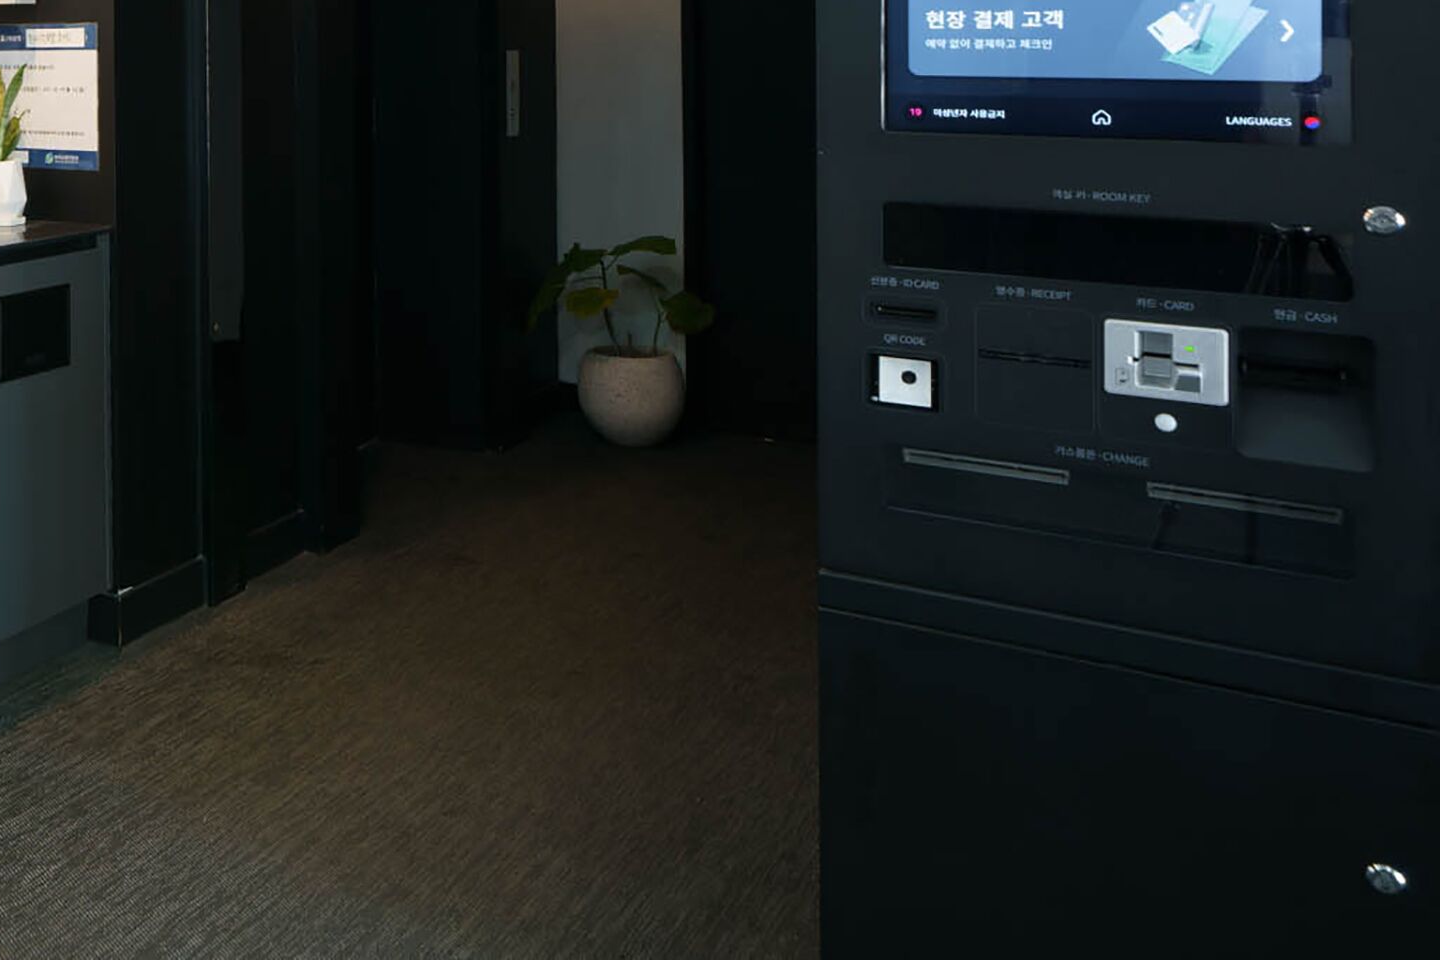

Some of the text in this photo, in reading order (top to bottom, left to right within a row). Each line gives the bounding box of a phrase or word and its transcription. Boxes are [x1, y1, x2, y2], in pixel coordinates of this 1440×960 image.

[925, 9, 1065, 30] 현장 결제 고객
[1225, 115, 1293, 127] LANGUAGES
[1304, 310, 1338, 324] CASH
